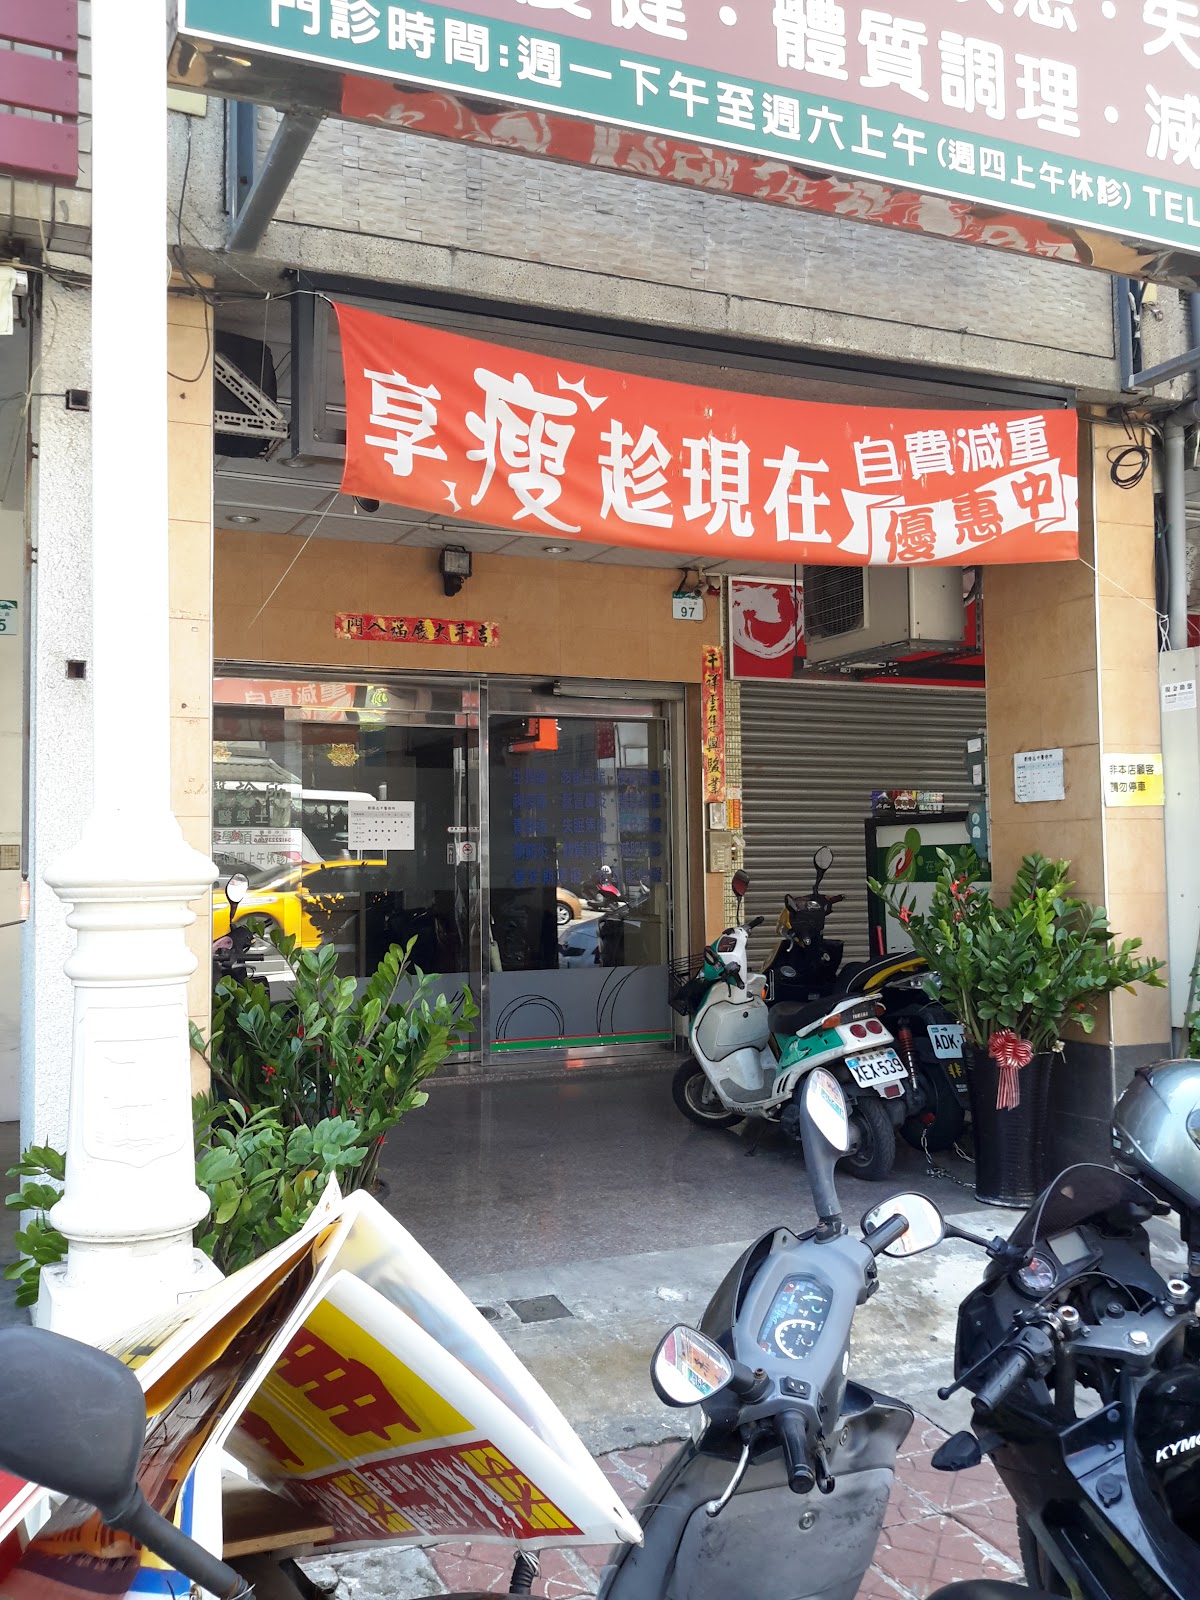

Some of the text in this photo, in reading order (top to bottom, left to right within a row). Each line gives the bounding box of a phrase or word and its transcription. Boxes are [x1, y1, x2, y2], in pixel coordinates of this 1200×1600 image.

[852, 415, 1051, 487] 自費減重
[885, 470, 1056, 563] 優惠中
[680, 606, 695, 618] 97
